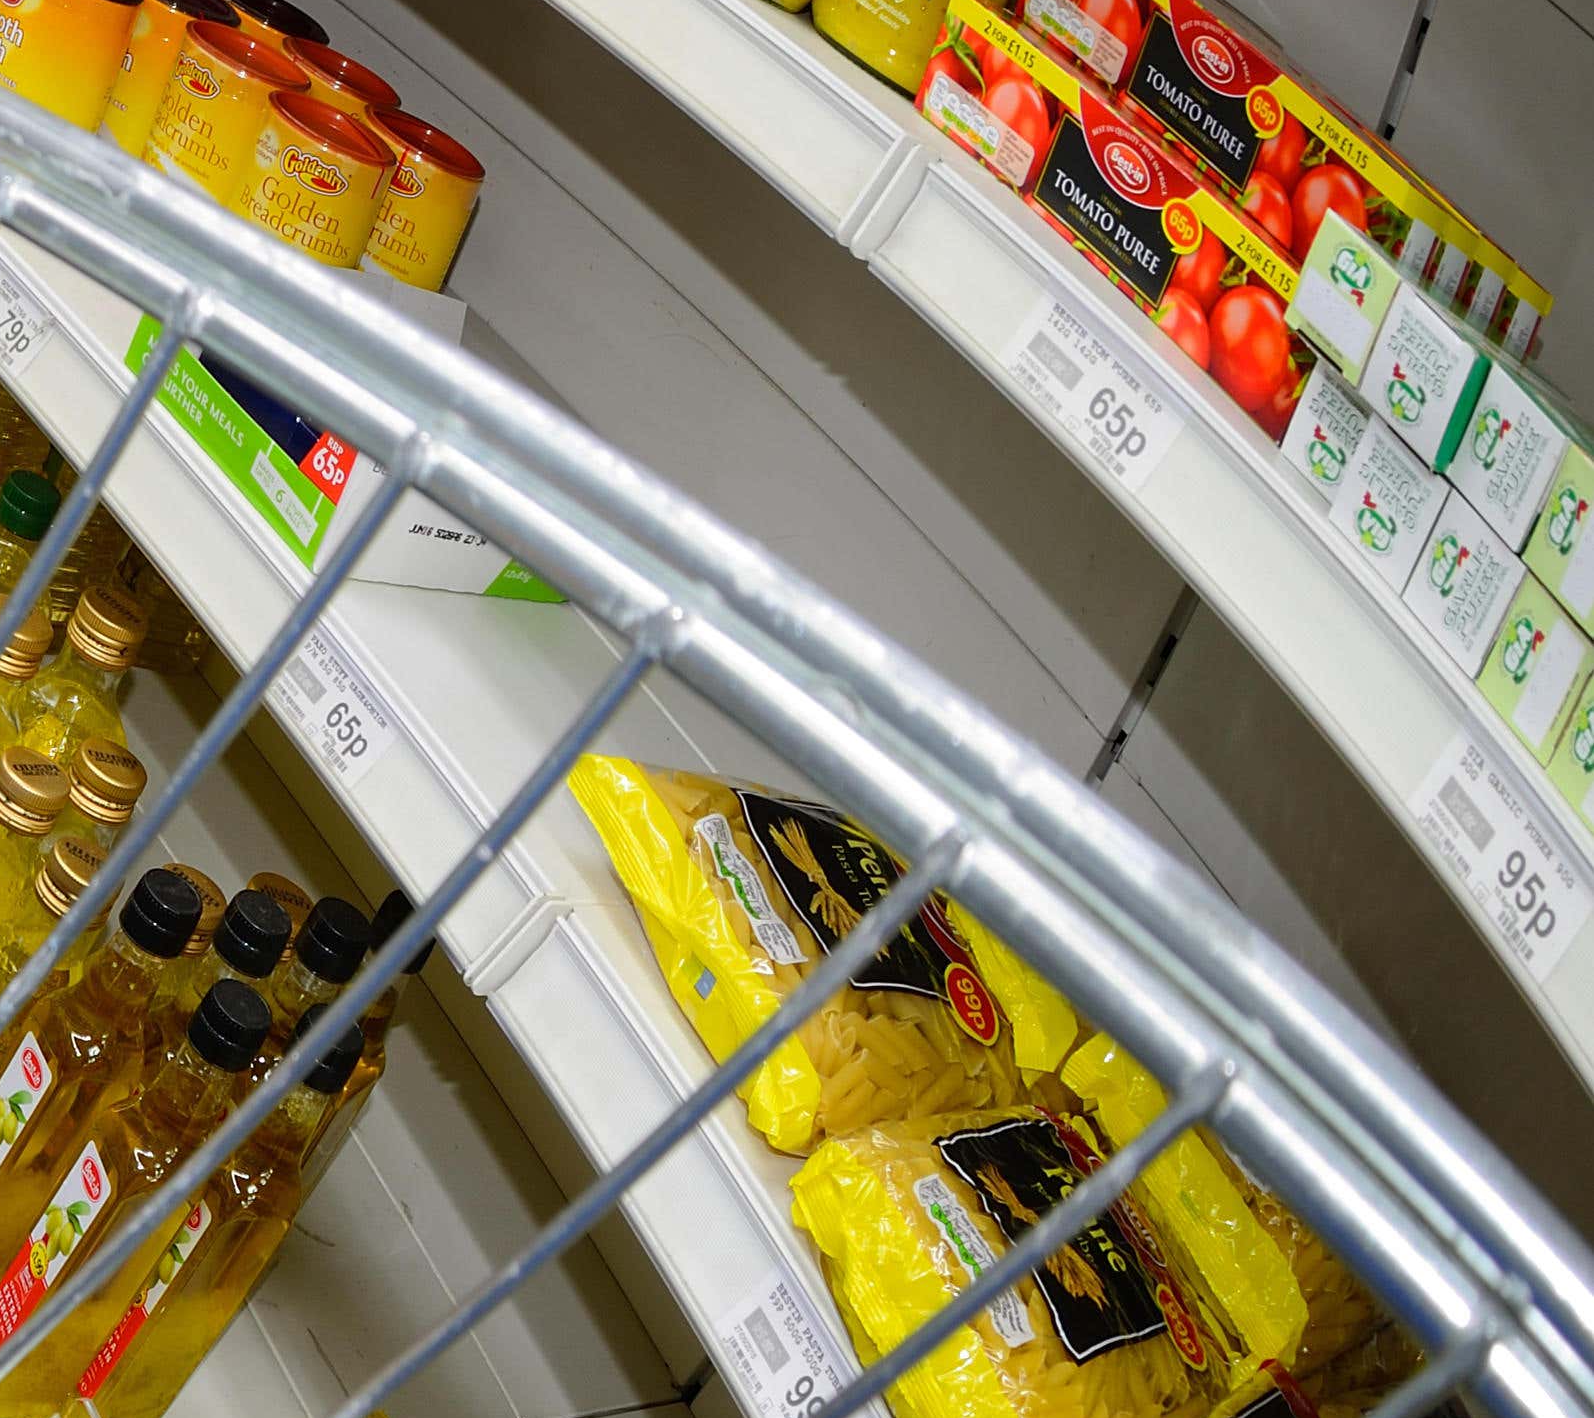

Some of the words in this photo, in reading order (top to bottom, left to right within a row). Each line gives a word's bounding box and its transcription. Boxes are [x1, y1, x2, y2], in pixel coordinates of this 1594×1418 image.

[1145, 64, 1202, 124] TOMATO
[1204, 114, 1247, 162] PUREE
[1109, 149, 1145, 185] Best-in
[1054, 168, 1113, 232] TOMATO
[1115, 225, 1162, 276] PUREE
[1088, 386, 1148, 459] 65p
[326, 703, 368, 758] 65p
[1460, 758, 1478, 782] 90G
[1467, 745, 1484, 771] GIA
[1488, 773, 1522, 819] GARLIC
[1524, 821, 1553, 861] PUREE
[1556, 863, 1574, 890] 90G
[833, 844, 859, 884] Pasta
[1498, 851, 1556, 938] 95p
[1, 1282, 18, 1324] EXTRA
[776, 1281, 802, 1326] BESTIN
[802, 1322, 826, 1363] PASTA
